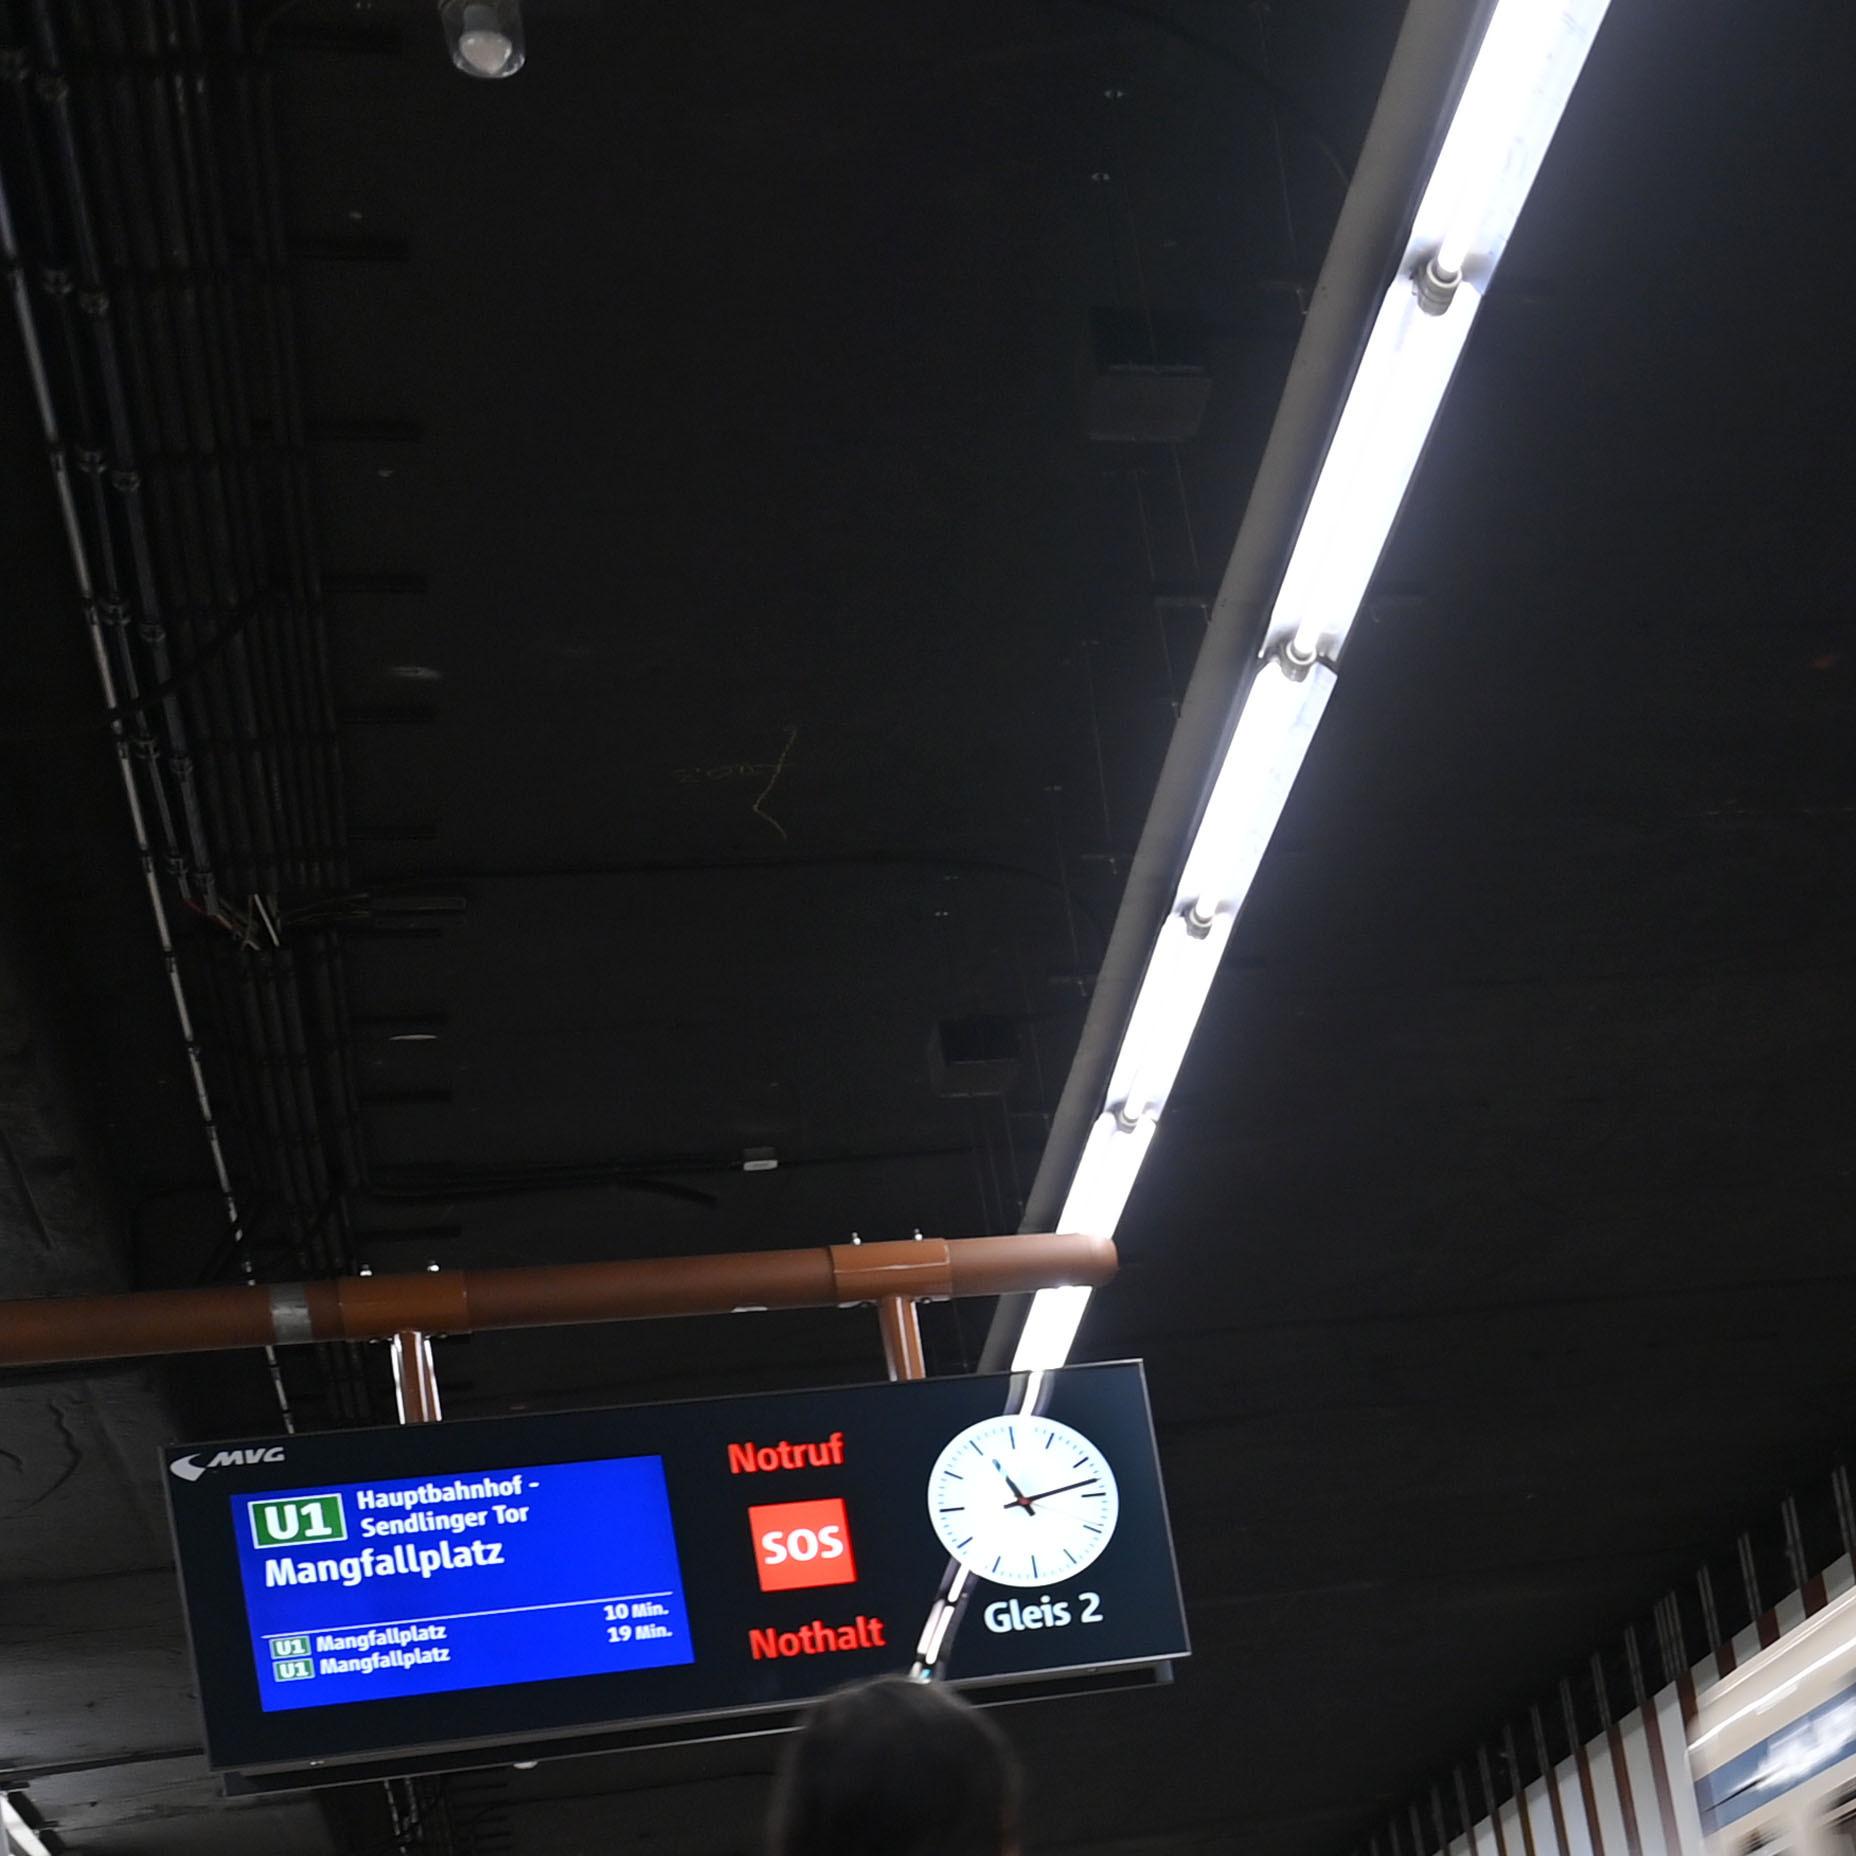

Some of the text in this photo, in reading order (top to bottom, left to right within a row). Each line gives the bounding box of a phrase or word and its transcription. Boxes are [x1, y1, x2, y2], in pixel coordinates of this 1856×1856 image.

[207, 1447, 285, 1468] MVG
[727, 1432, 845, 1475] Notruf
[357, 1475, 522, 1511] Hauptbahnhof
[263, 1502, 332, 1540] U1
[360, 1505, 529, 1538] Sendlinger Tor
[265, 1540, 505, 1588] Mangfallplatz
[761, 1525, 844, 1565] SOS
[275, 1601, 670, 1656] U1 Mangfallplatz 10 Min.
[983, 1592, 1104, 1634] Gleis 2
[278, 1623, 673, 1679] U1 Mangfallplatz 19 Min.
[748, 1615, 887, 1660] Nothalt
